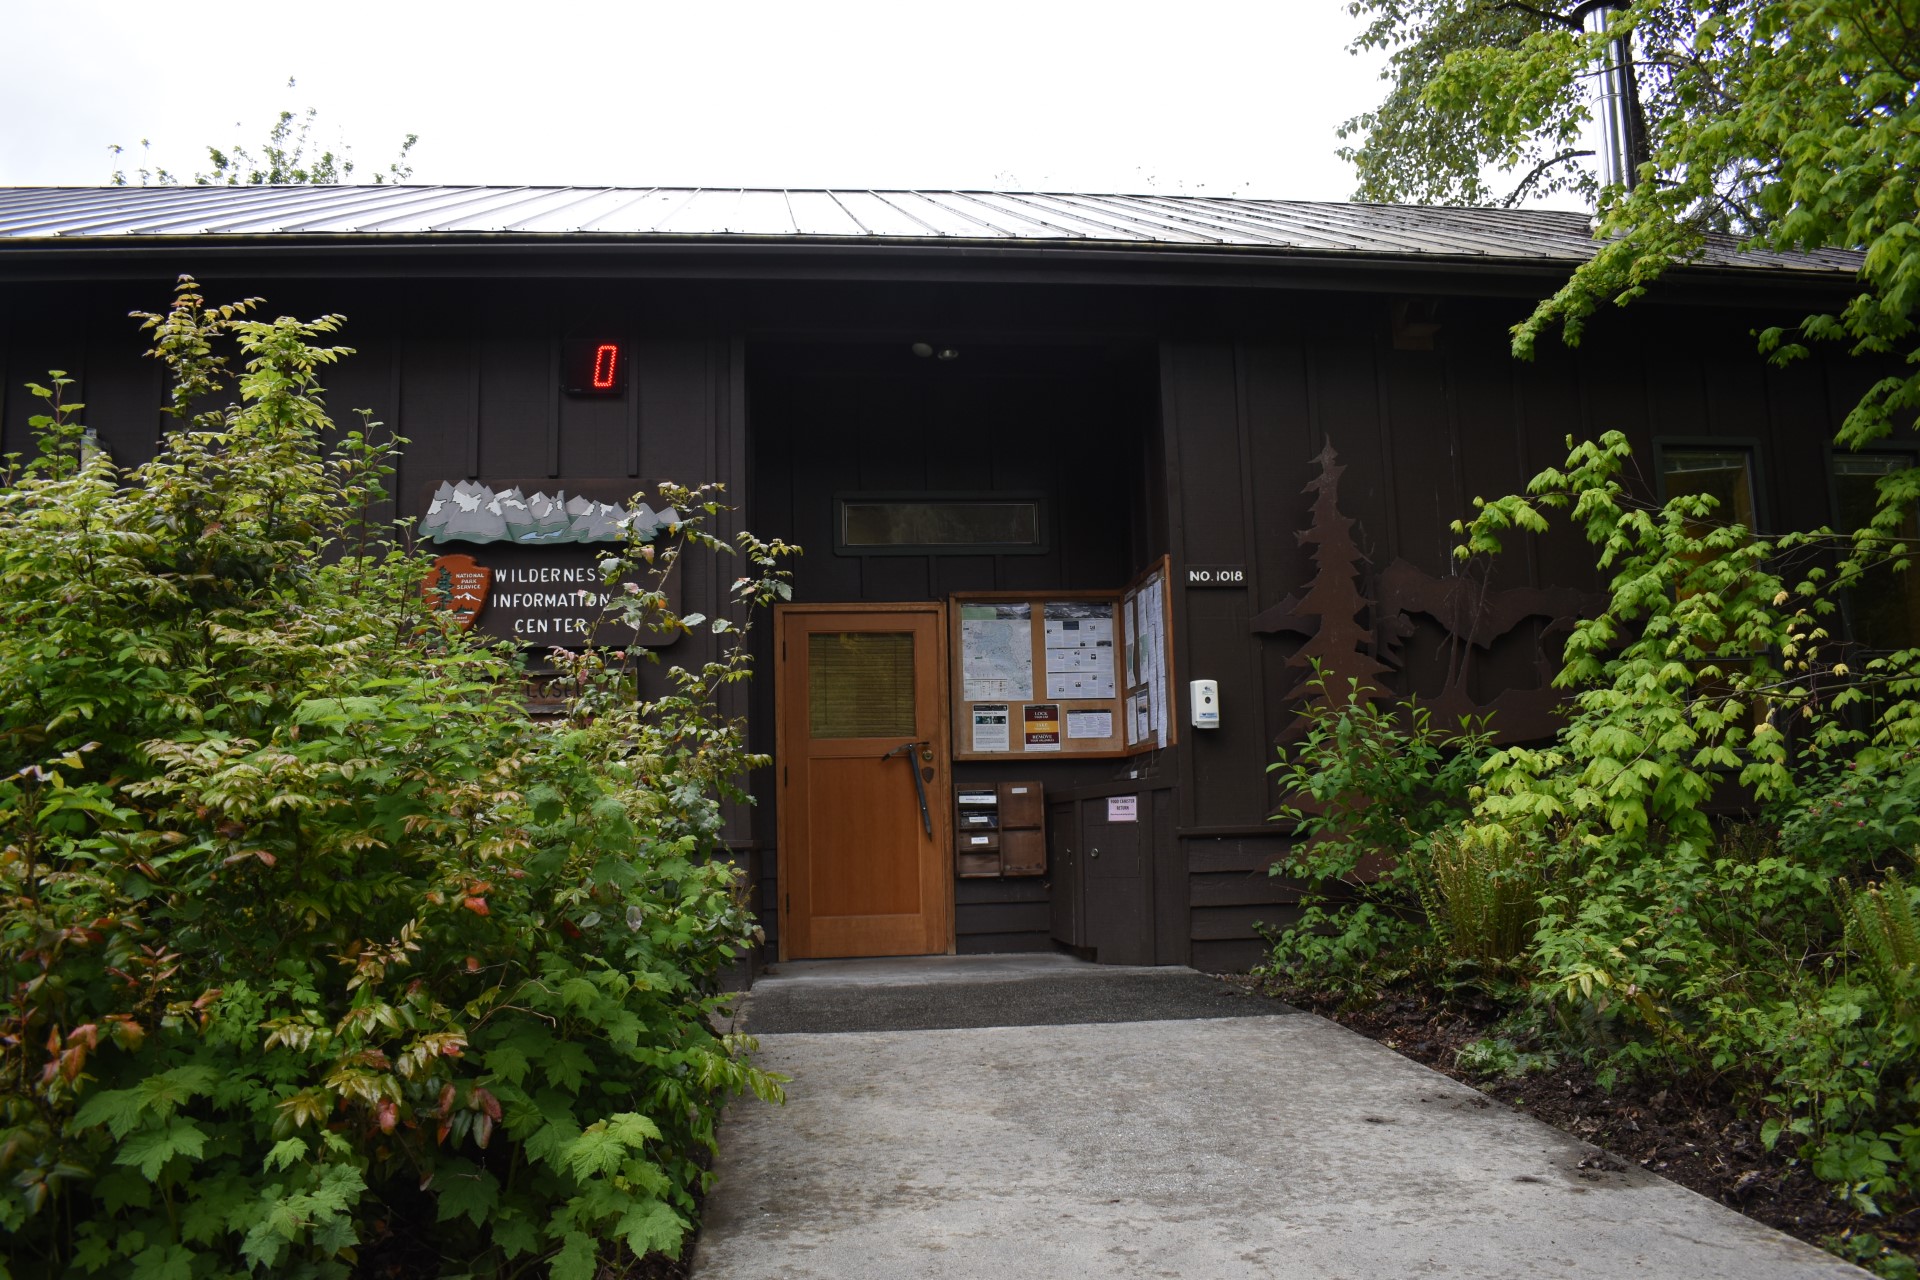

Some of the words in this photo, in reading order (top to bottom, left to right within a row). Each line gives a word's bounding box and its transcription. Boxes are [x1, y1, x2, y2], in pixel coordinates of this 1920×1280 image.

[594, 345, 617, 387] 0
[1189, 570, 1214, 582] NO.
[1216, 570, 1244, 582] 1018
[515, 618, 586, 633] CENTER
